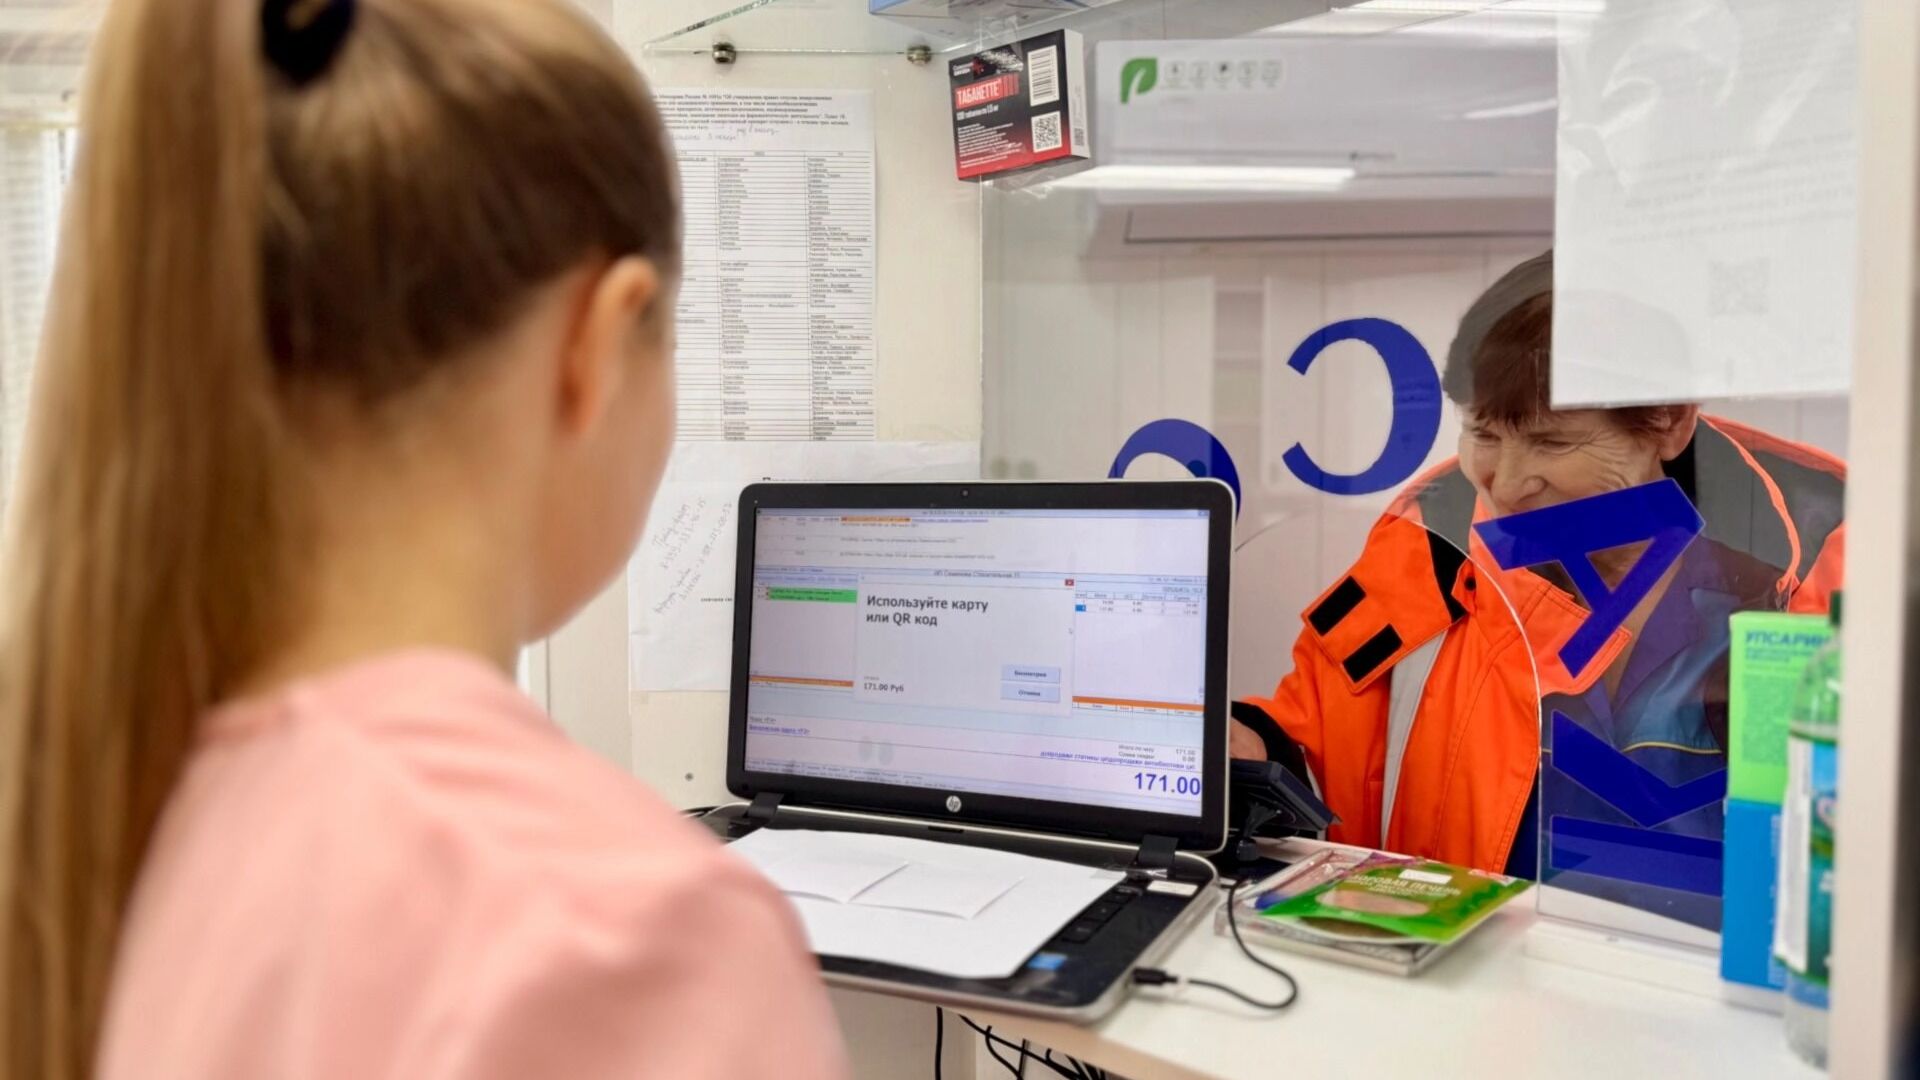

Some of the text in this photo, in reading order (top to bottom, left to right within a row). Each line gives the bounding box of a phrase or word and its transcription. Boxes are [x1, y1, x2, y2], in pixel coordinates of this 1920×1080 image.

[867, 595, 988, 613] Используйте карту
[866, 612, 938, 626] или QR код
[863, 682, 889, 691] 171.00
[1134, 772, 1201, 795] 171.00
[946, 795, 961, 812] hp
